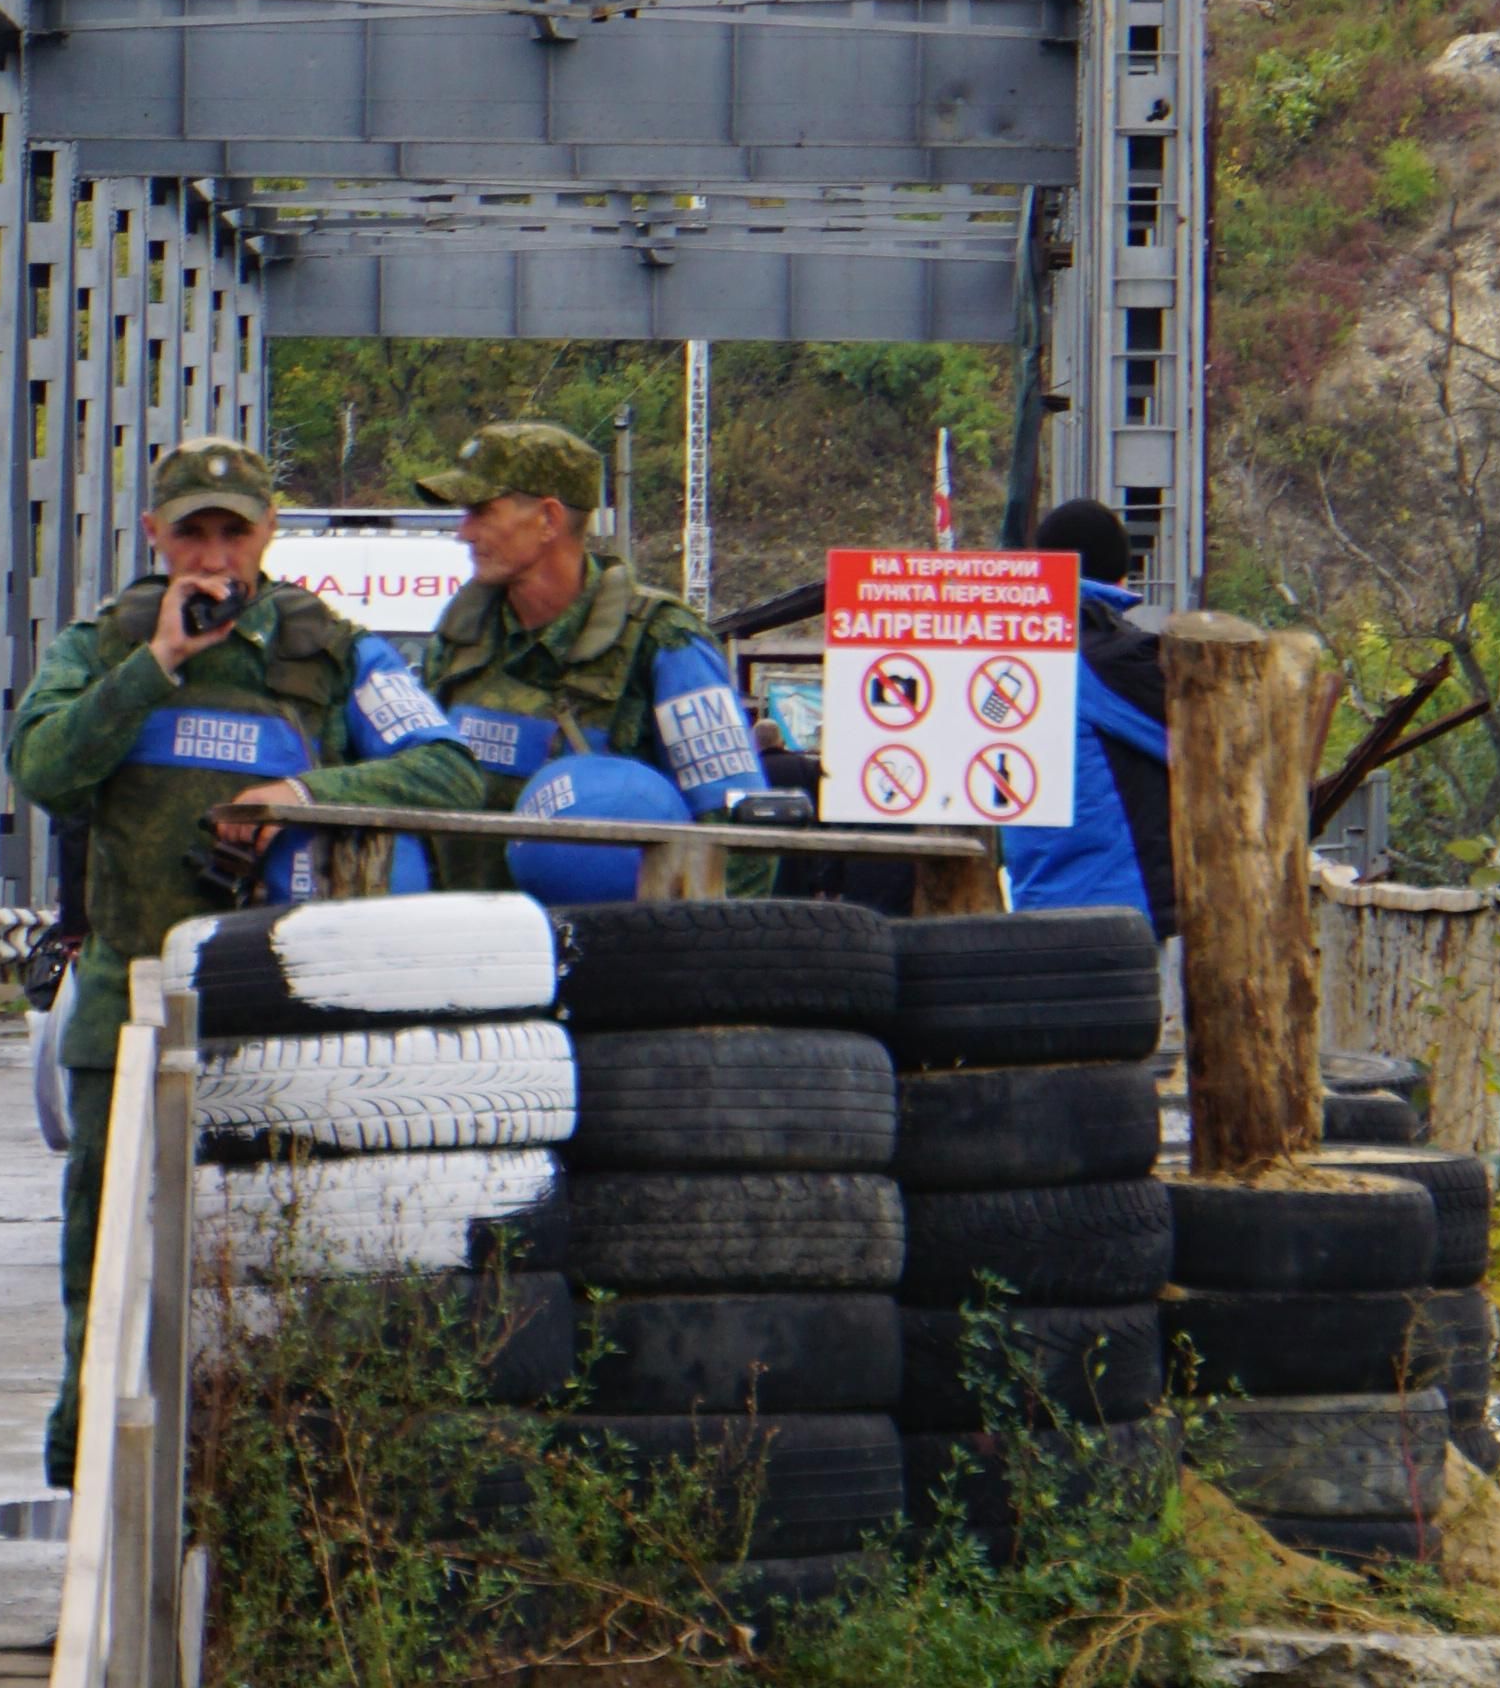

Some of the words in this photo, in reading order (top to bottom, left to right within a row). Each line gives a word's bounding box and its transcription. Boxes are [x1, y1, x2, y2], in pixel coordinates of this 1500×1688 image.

[871, 557, 901, 576] НА
[907, 558, 1039, 578] ТЕРРИТОРИИ
[858, 583, 937, 603] ПУНКТА
[941, 583, 1051, 606] ПЕРЕХОДА
[833, 611, 1074, 645] ЗАПРЕЩАЕТСЯ:
[671, 692, 730, 737] НМ
